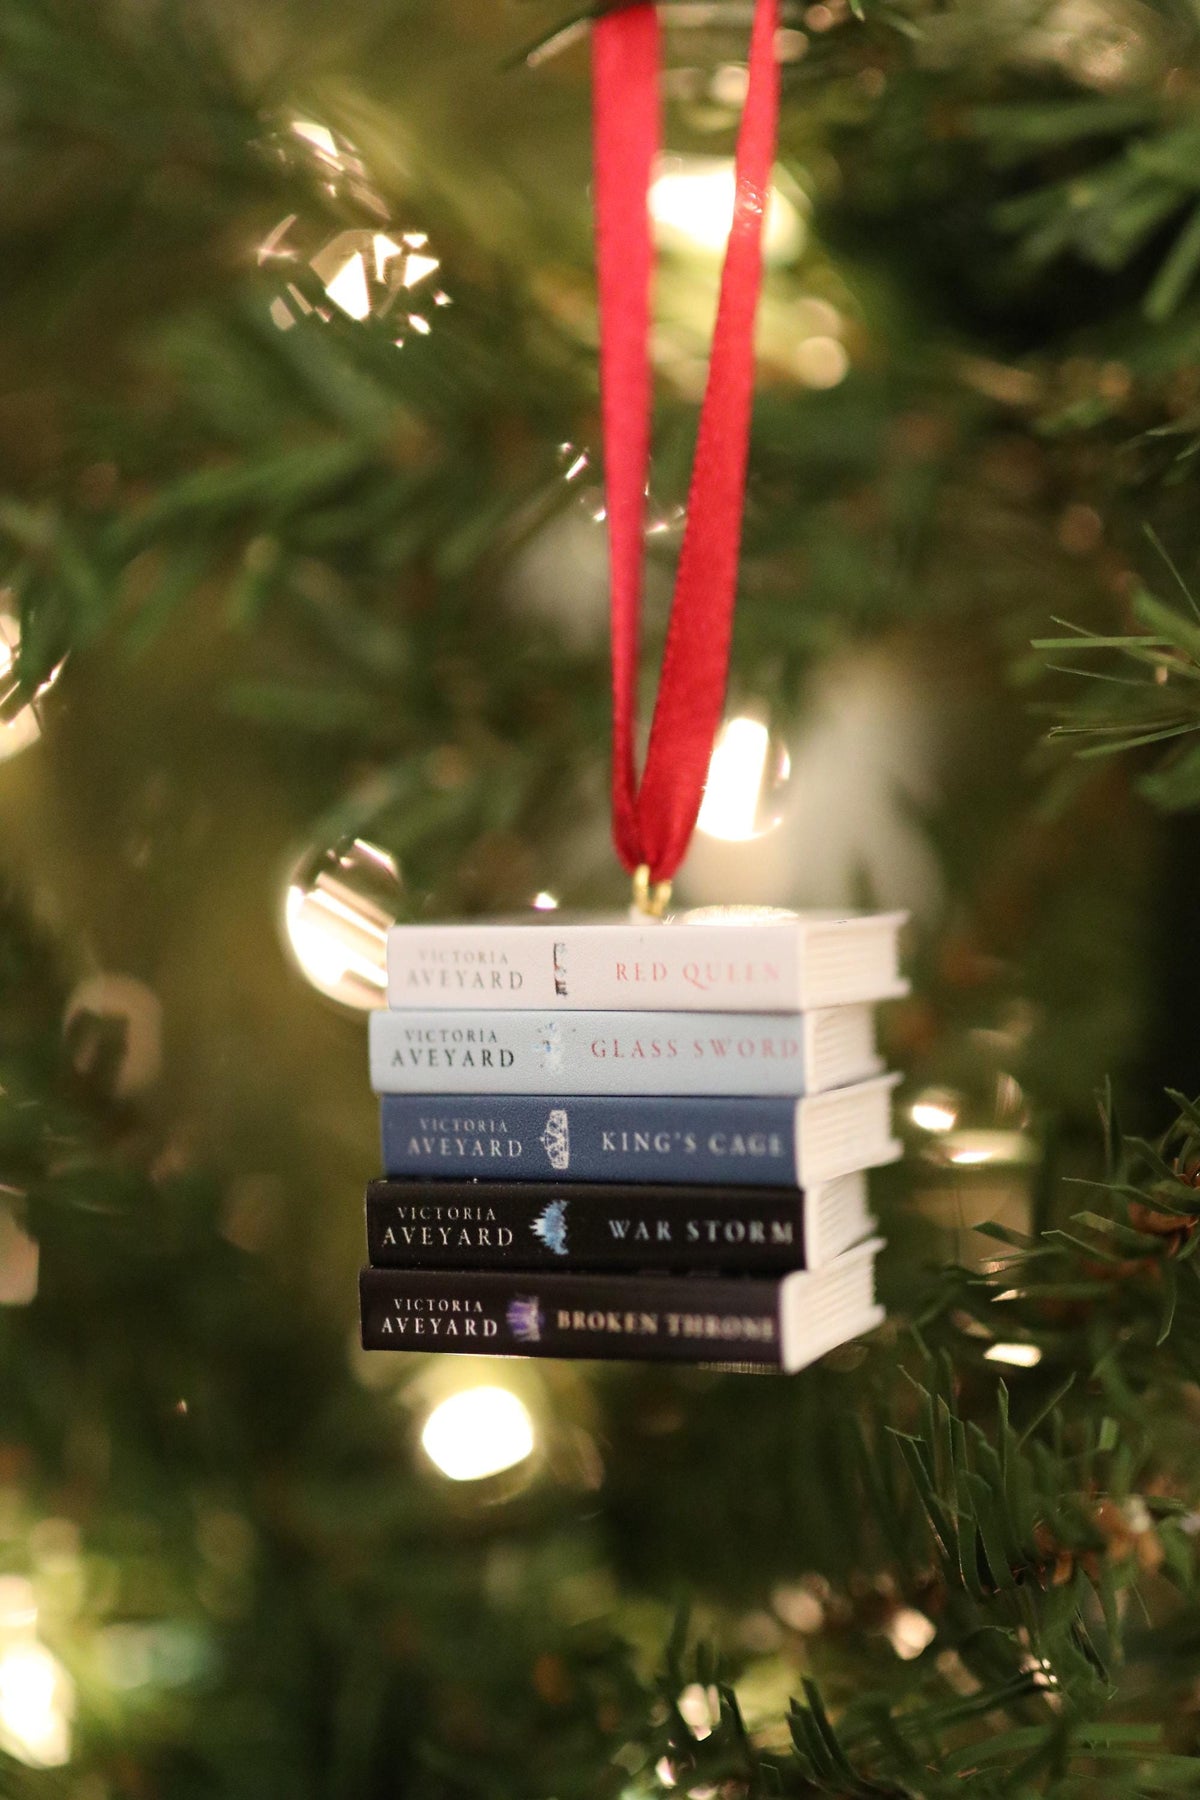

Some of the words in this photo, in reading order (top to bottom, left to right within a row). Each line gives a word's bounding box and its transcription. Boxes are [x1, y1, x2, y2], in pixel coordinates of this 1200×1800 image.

[419, 951, 508, 965] VICTORIA
[407, 969, 523, 990] AVEYARD
[615, 962, 668, 982] RED
[682, 962, 780, 991] QUEEN
[404, 1027, 498, 1043] VICTORIA
[391, 1048, 515, 1068] AVEYARD
[590, 1039, 679, 1059] GLASS
[693, 1038, 799, 1059] SWORD
[419, 1118, 509, 1133] VICTORIA
[407, 1137, 523, 1158] AVEYARD
[601, 1131, 697, 1154] KING'S
[707, 1132, 784, 1158] CAGE
[397, 1207, 497, 1221] VICTORIA
[382, 1226, 514, 1247] AVEYARD
[608, 1219, 673, 1241] WAR
[685, 1219, 794, 1245] STORM
[393, 1298, 484, 1313] VICTORIA
[381, 1317, 499, 1337] AVEYARD
[557, 1309, 660, 1335] BROKEN
[665, 1313, 776, 1343] THRONE
